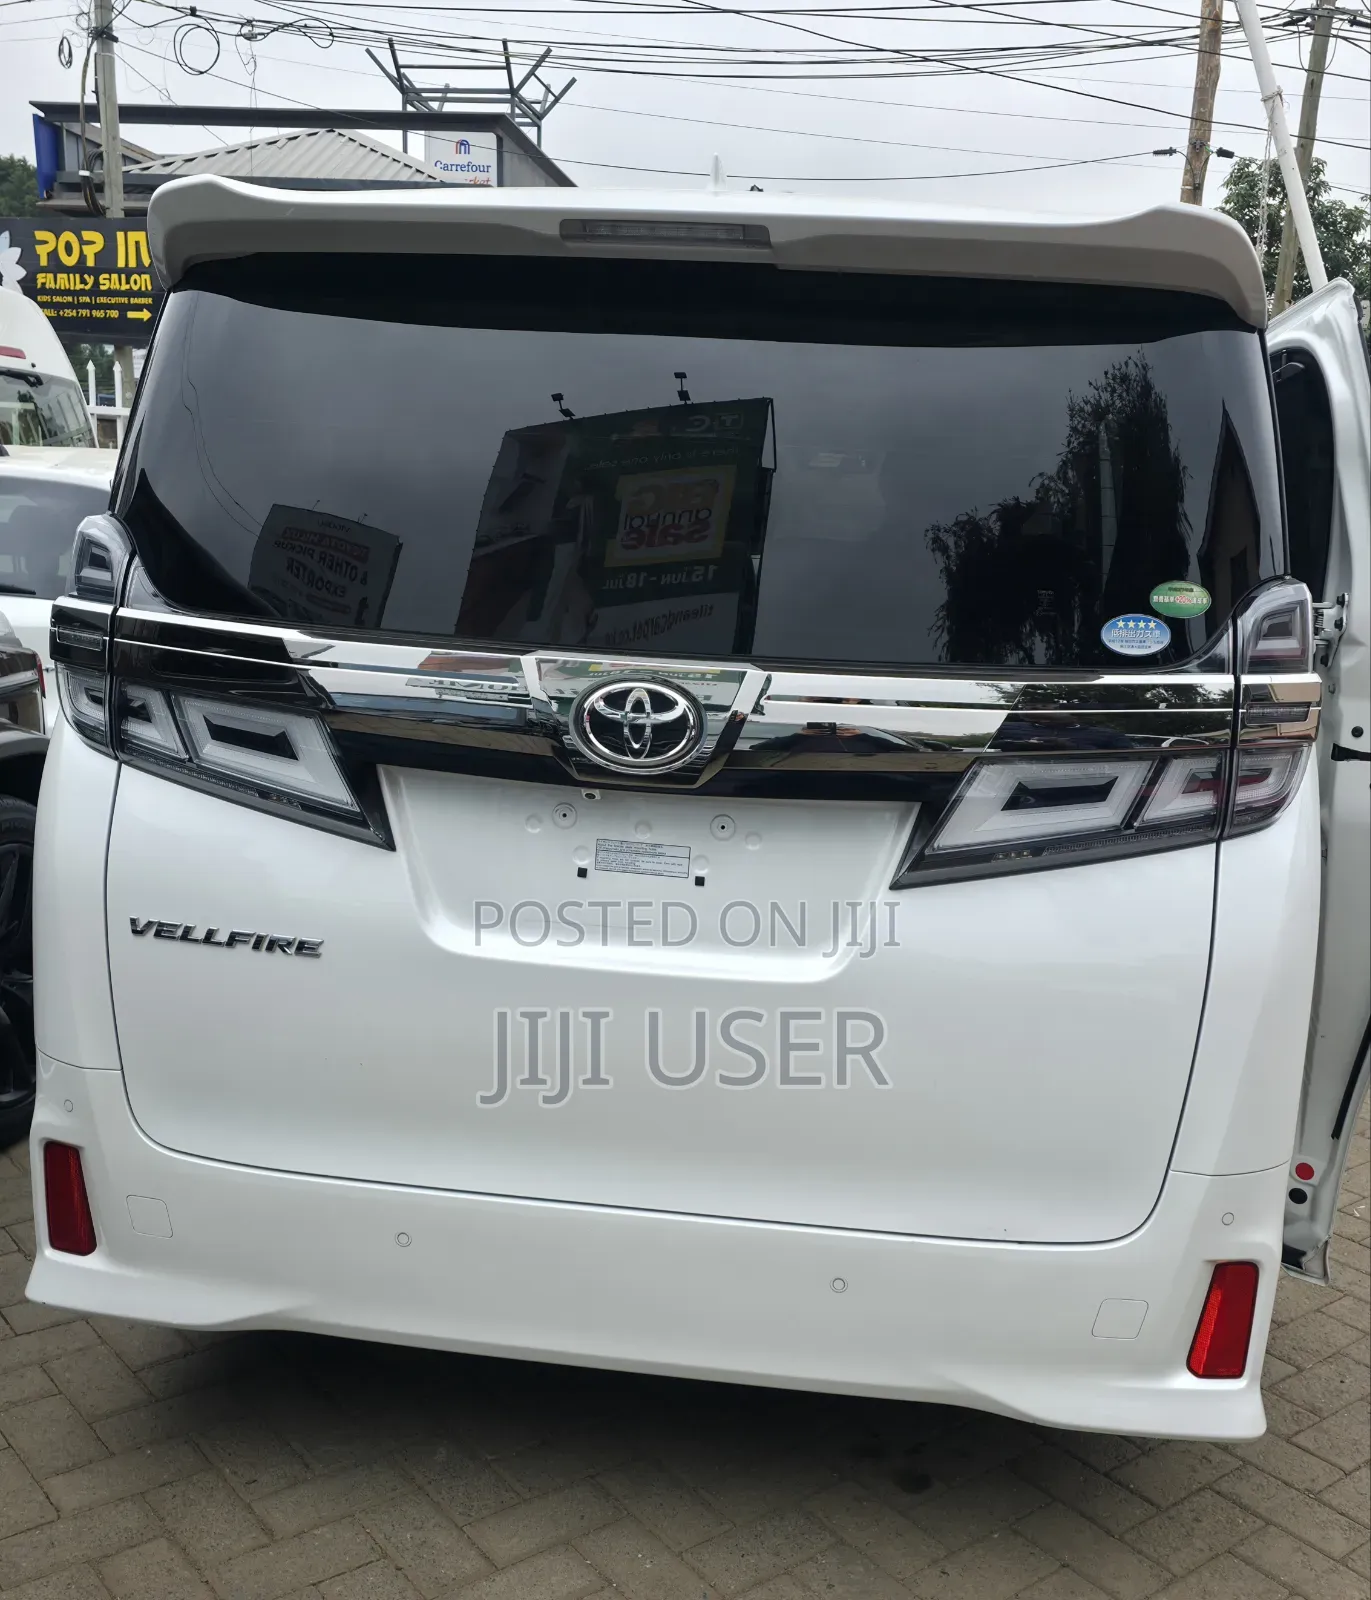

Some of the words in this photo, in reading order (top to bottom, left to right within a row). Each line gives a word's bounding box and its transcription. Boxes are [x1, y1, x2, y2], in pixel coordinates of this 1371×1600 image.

[434, 160, 491, 173] Carrefour
[34, 231, 104, 267] POP
[116, 231, 152, 268] IN
[36, 273, 94, 291] FAMILY
[99, 273, 152, 291] SALON
[59, 308, 77, 317] +254
[78, 309, 90, 318] 791
[92, 309, 105, 318] 965
[106, 309, 119, 318] 700
[129, 915, 324, 958] VELLFIRE
